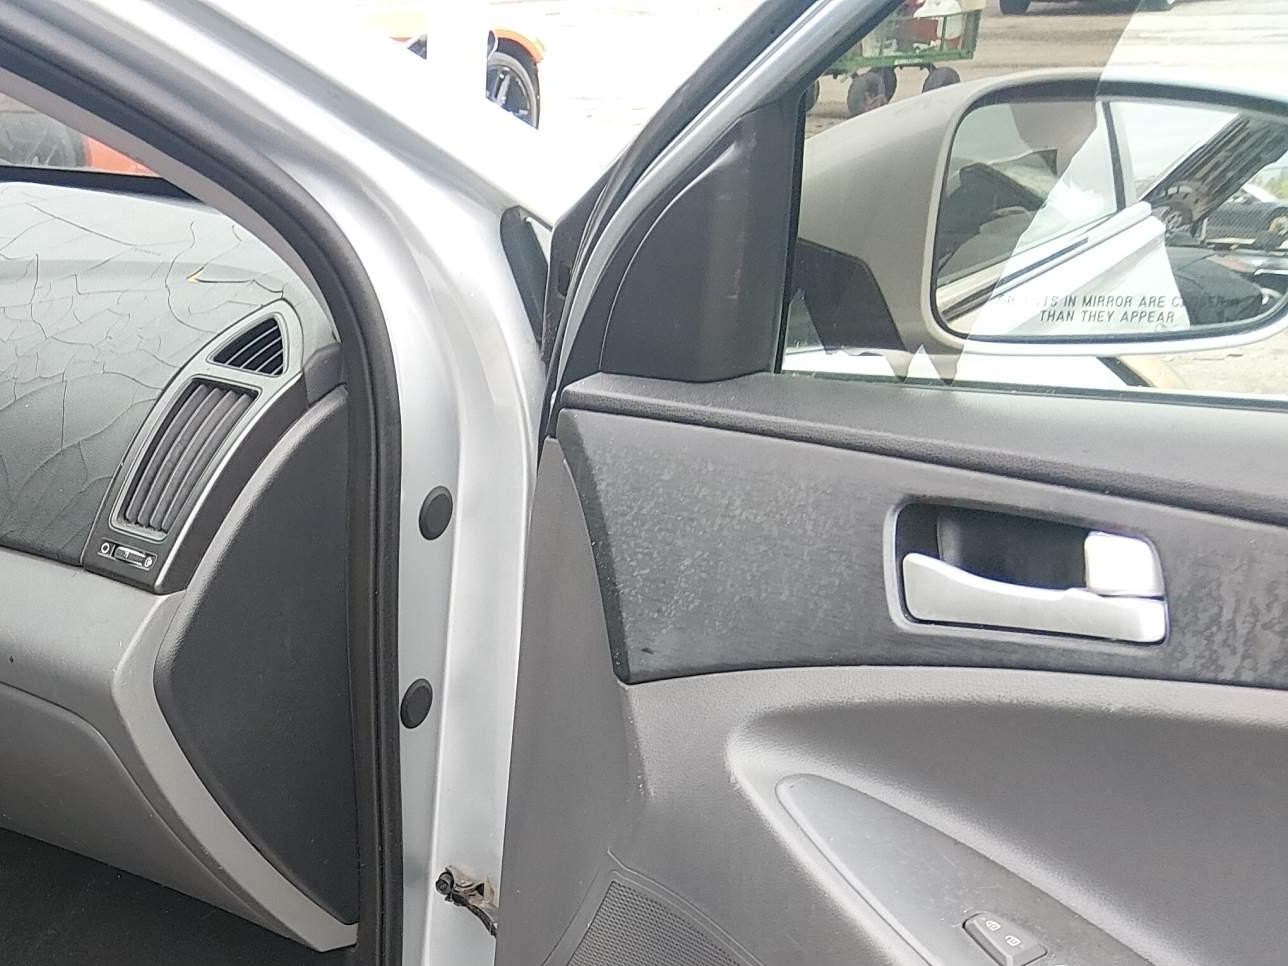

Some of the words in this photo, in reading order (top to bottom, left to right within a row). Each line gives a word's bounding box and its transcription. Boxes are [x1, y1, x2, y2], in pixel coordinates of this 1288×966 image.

[1063, 295, 1078, 308] IN
[1081, 295, 1132, 308] MIRROR
[1137, 296, 1166, 308] ARE
[1039, 309, 1076, 323] THAN
[1080, 309, 1116, 323] THEY
[1119, 310, 1176, 324] APPEAR
